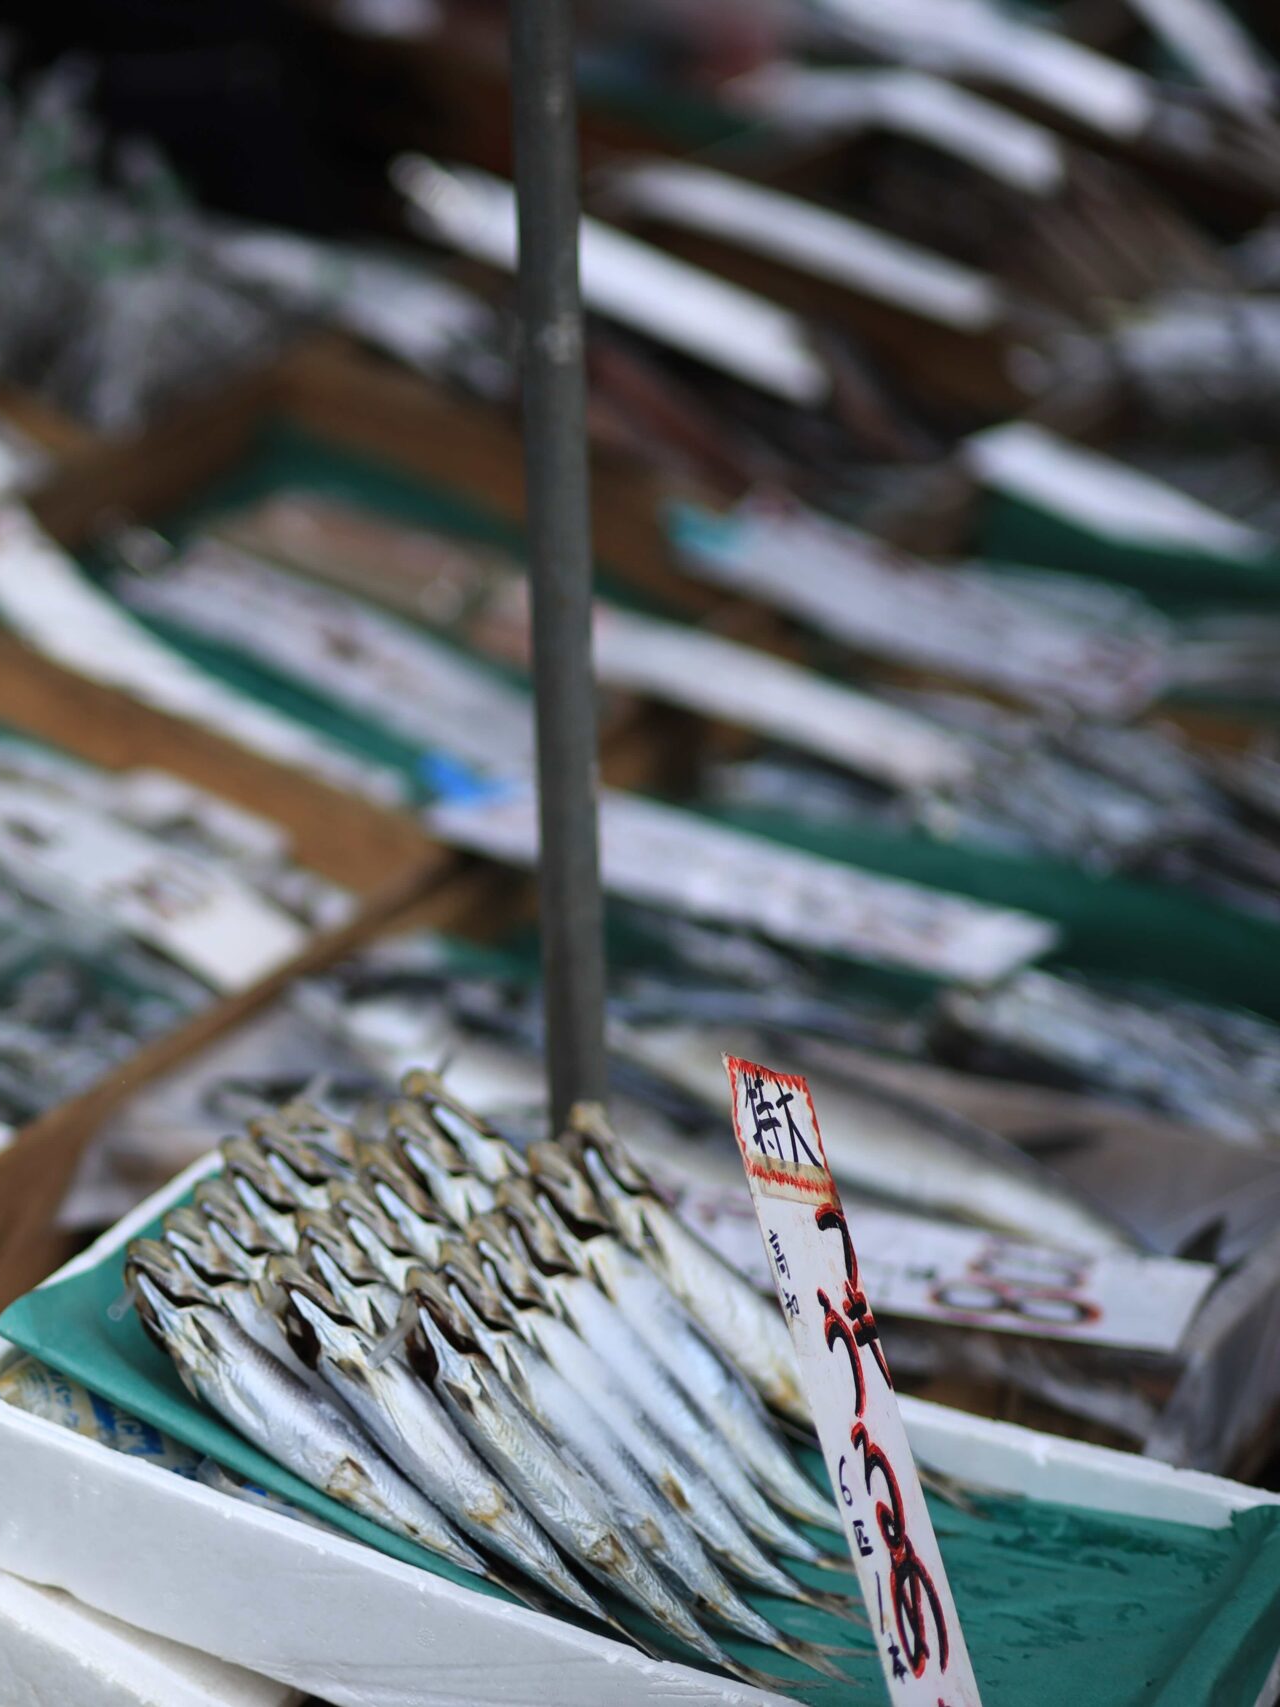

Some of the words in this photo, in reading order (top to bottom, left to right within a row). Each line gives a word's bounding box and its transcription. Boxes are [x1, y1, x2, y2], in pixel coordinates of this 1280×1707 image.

[743, 1072, 823, 1170] 特大
[816, 1287, 950, 1680] うるめ
